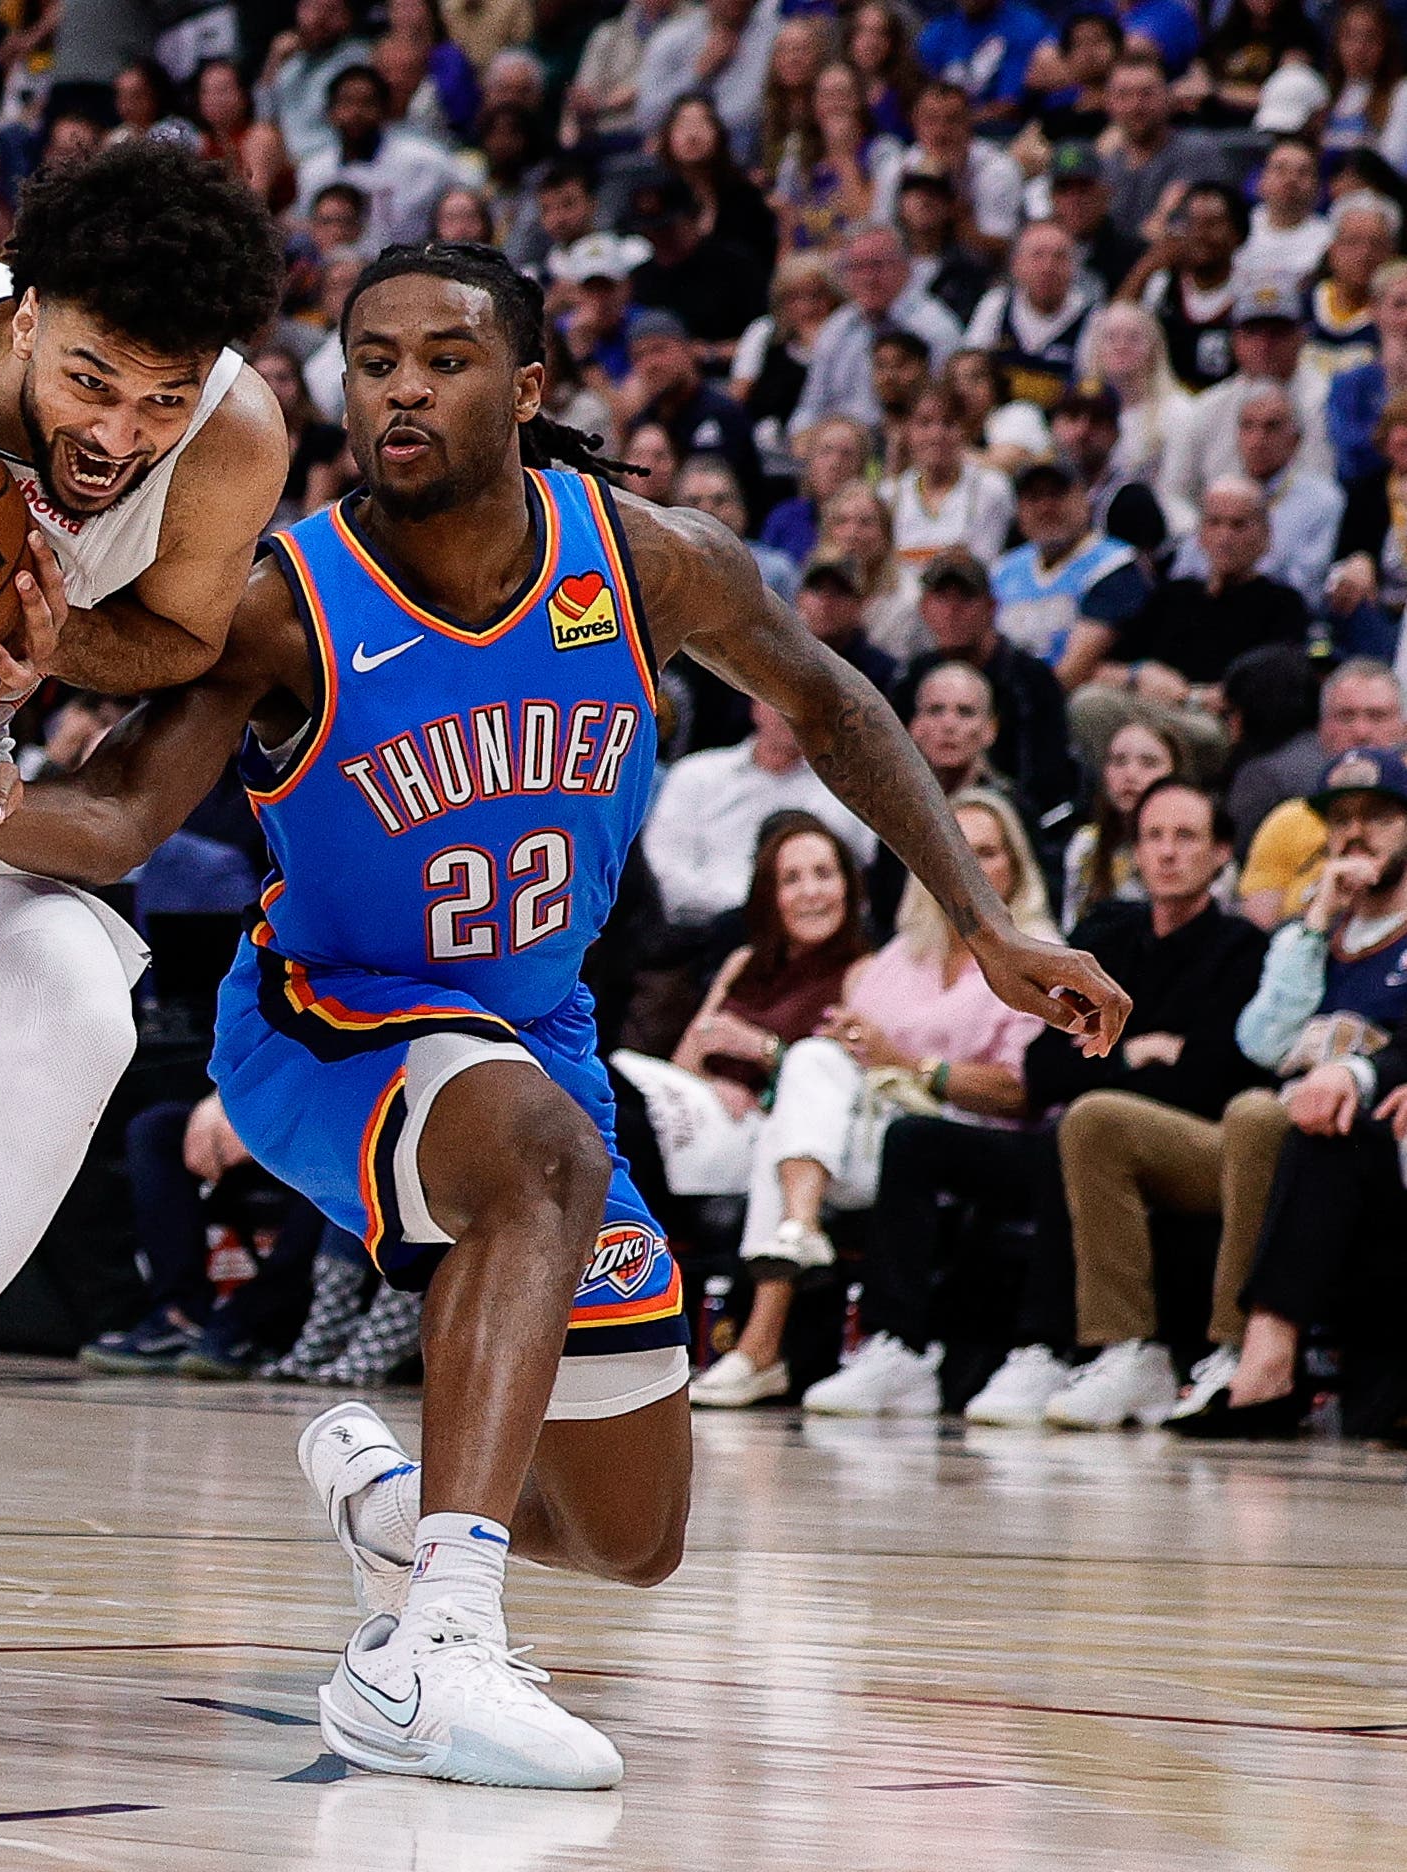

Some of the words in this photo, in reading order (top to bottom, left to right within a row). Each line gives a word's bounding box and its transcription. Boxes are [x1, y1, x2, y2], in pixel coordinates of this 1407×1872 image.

[339, 699, 639, 837] THUNDER
[424, 826, 575, 963] 22
[585, 1235, 645, 1283] OKC
